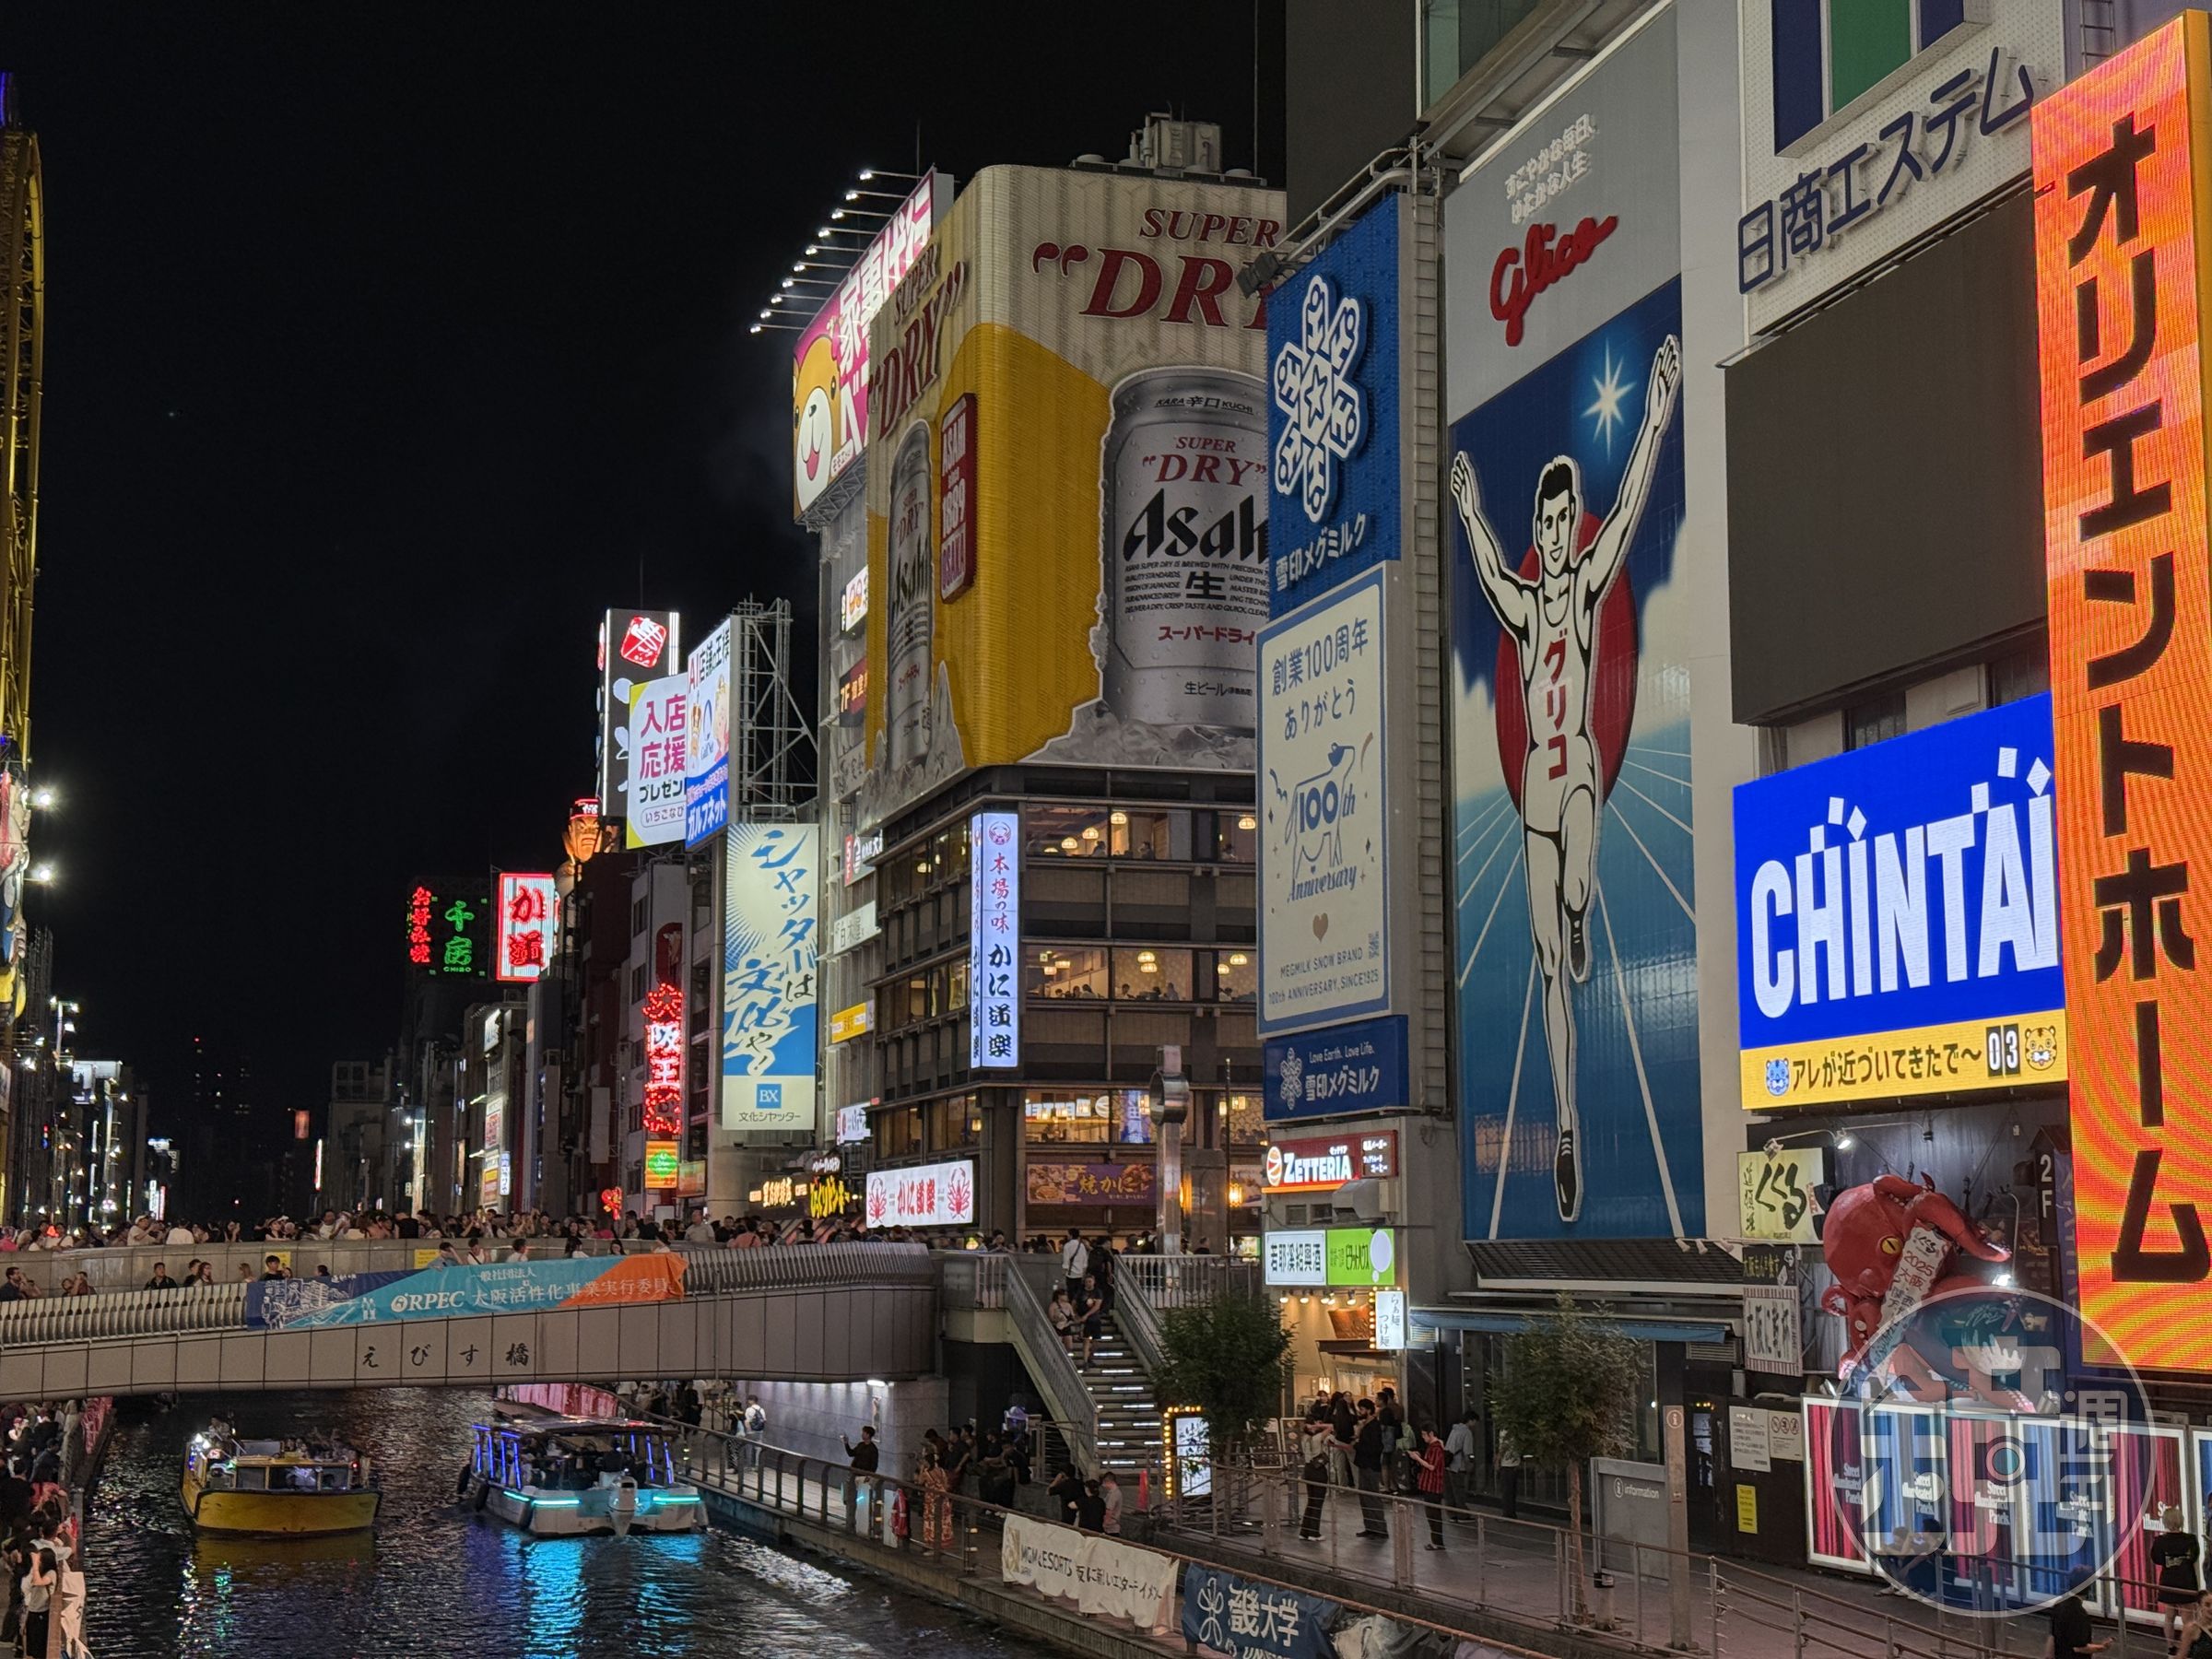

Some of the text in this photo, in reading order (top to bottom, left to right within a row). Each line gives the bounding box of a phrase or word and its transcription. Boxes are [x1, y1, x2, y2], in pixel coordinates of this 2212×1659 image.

[1738, 46, 2035, 295] 日商エステム
[1139, 207, 1280, 247] SUPER
[840, 180, 932, 377] 家事代行
[895, 243, 939, 325] SUPER
[1489, 215, 1618, 347] Glico
[1155, 398, 1184, 407] KARA
[1222, 401, 1253, 414] KUCHI
[1176, 437, 1236, 453] SUPER
[942, 478, 966, 538] 1889
[1141, 562, 1159, 571] SUPER
[1211, 562, 1230, 571] WITH
[1276, 512, 1368, 593] 雪印メグミルク
[1185, 571, 1226, 600] 生
[1206, 603, 1222, 611] AND
[1230, 585, 1258, 595] MASTER
[1158, 625, 1255, 645] スーパードライ
[1272, 617, 1369, 698] 創業100周年
[641, 694, 687, 737] 入店
[1284, 678, 1357, 741] ありがとう
[1543, 628, 1567, 781] グリコ
[2067, 111, 2210, 1283] オリエントホーム
[640, 735, 687, 781] 応援
[688, 786, 726, 841] ガルフネット
[1300, 780, 1357, 834] 100th
[1287, 861, 1358, 904] Anniversary
[1752, 774, 2059, 1018] CHINTAI
[410, 887, 432, 963] お好み焼
[444, 900, 475, 966] 千房
[987, 852, 1012, 1059] 本場の味 かに道楽
[1280, 947, 1363, 979] MEGMILK SNOW BRAND
[1309, 1051, 1324, 1064] Love
[1345, 1044, 1359, 1058] Love
[1360, 1041, 1375, 1055] Life.
[1986, 1025, 2020, 1077] 03
[759, 1089, 779, 1102] BX
[1305, 1064, 1380, 1101] 雪印メグミルク
[1284, 1152, 1353, 1183] ZETTERIA
[2040, 1154, 2053, 1218] 2F
[897, 1177, 936, 1218] かに道楽
[1755, 1162, 1806, 1230] くくる
[471, 1266, 536, 1282] 一般社団法人
[1900, 1267, 1926, 1291] 大阪
[1904, 1250, 1936, 1277] 2025
[362, 1341, 531, 1369] えびす橋
[1625, 1484, 1660, 1501] information
